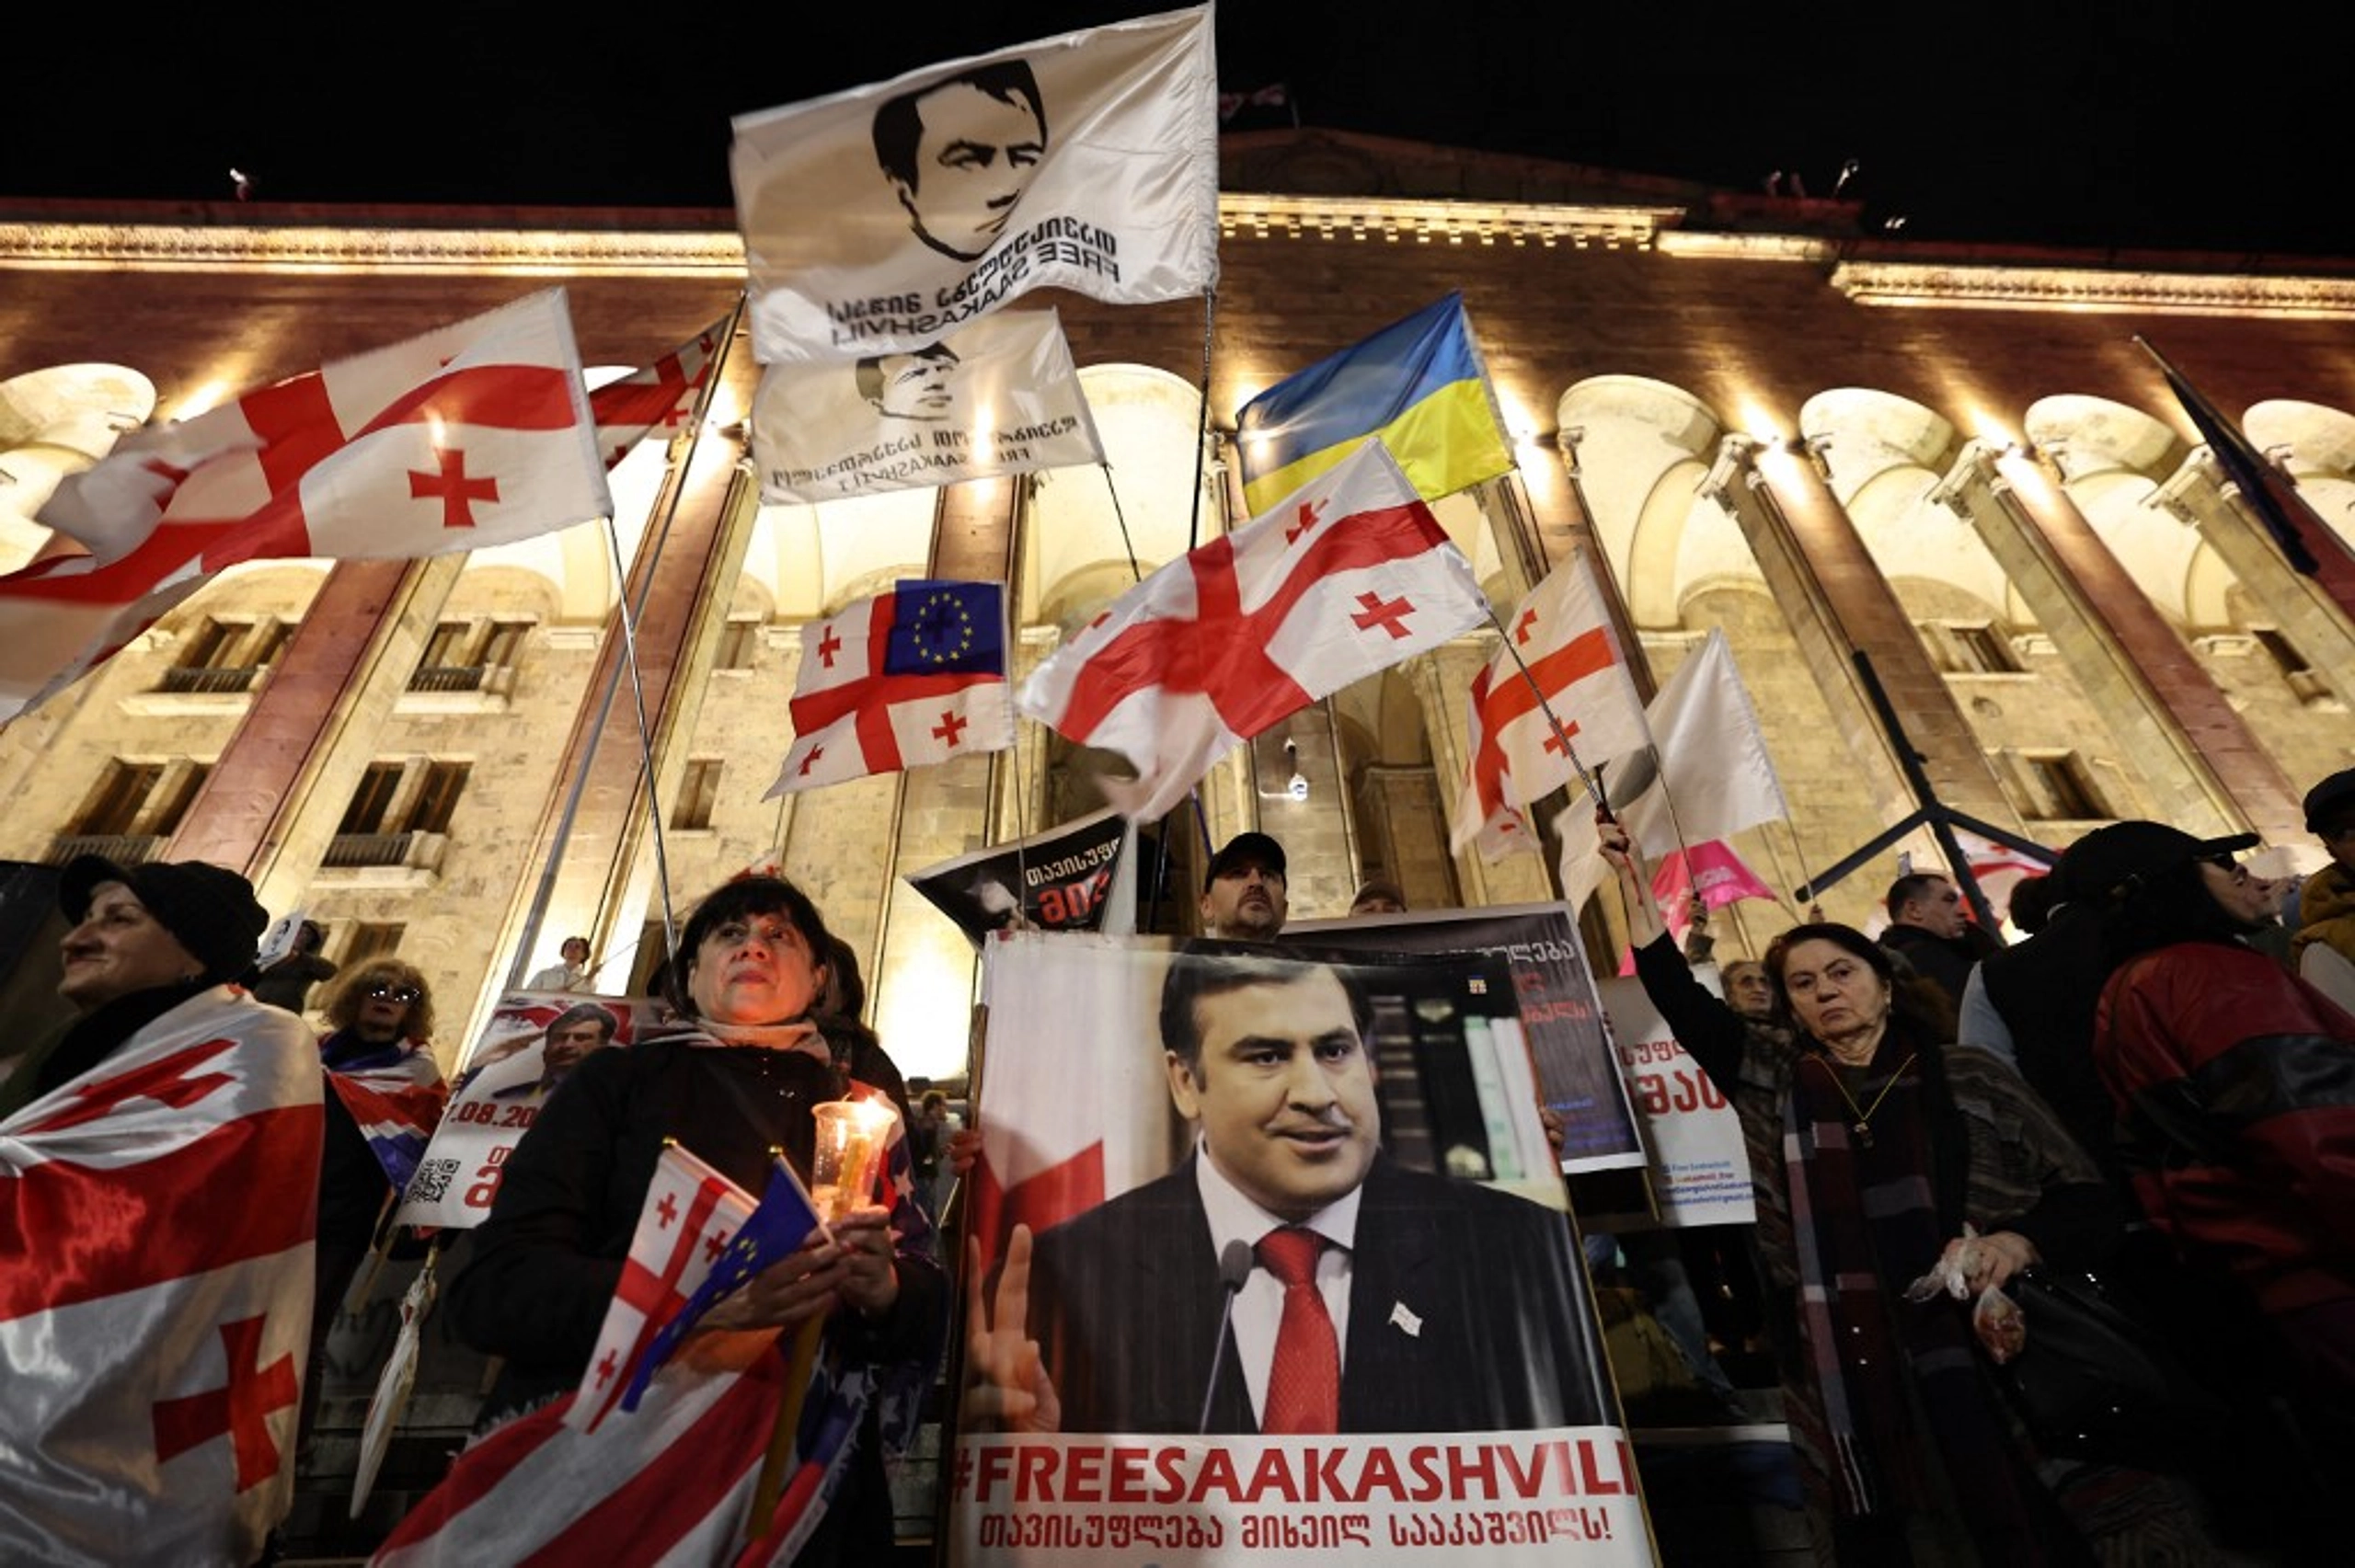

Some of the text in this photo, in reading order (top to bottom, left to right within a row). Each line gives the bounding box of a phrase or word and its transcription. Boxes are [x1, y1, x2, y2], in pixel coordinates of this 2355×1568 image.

[954, 1439, 1637, 1505] #FREESAAKASHVILI
[980, 1505, 1612, 1549] თავისუფლება მიხეილ სააკაშვილს!
